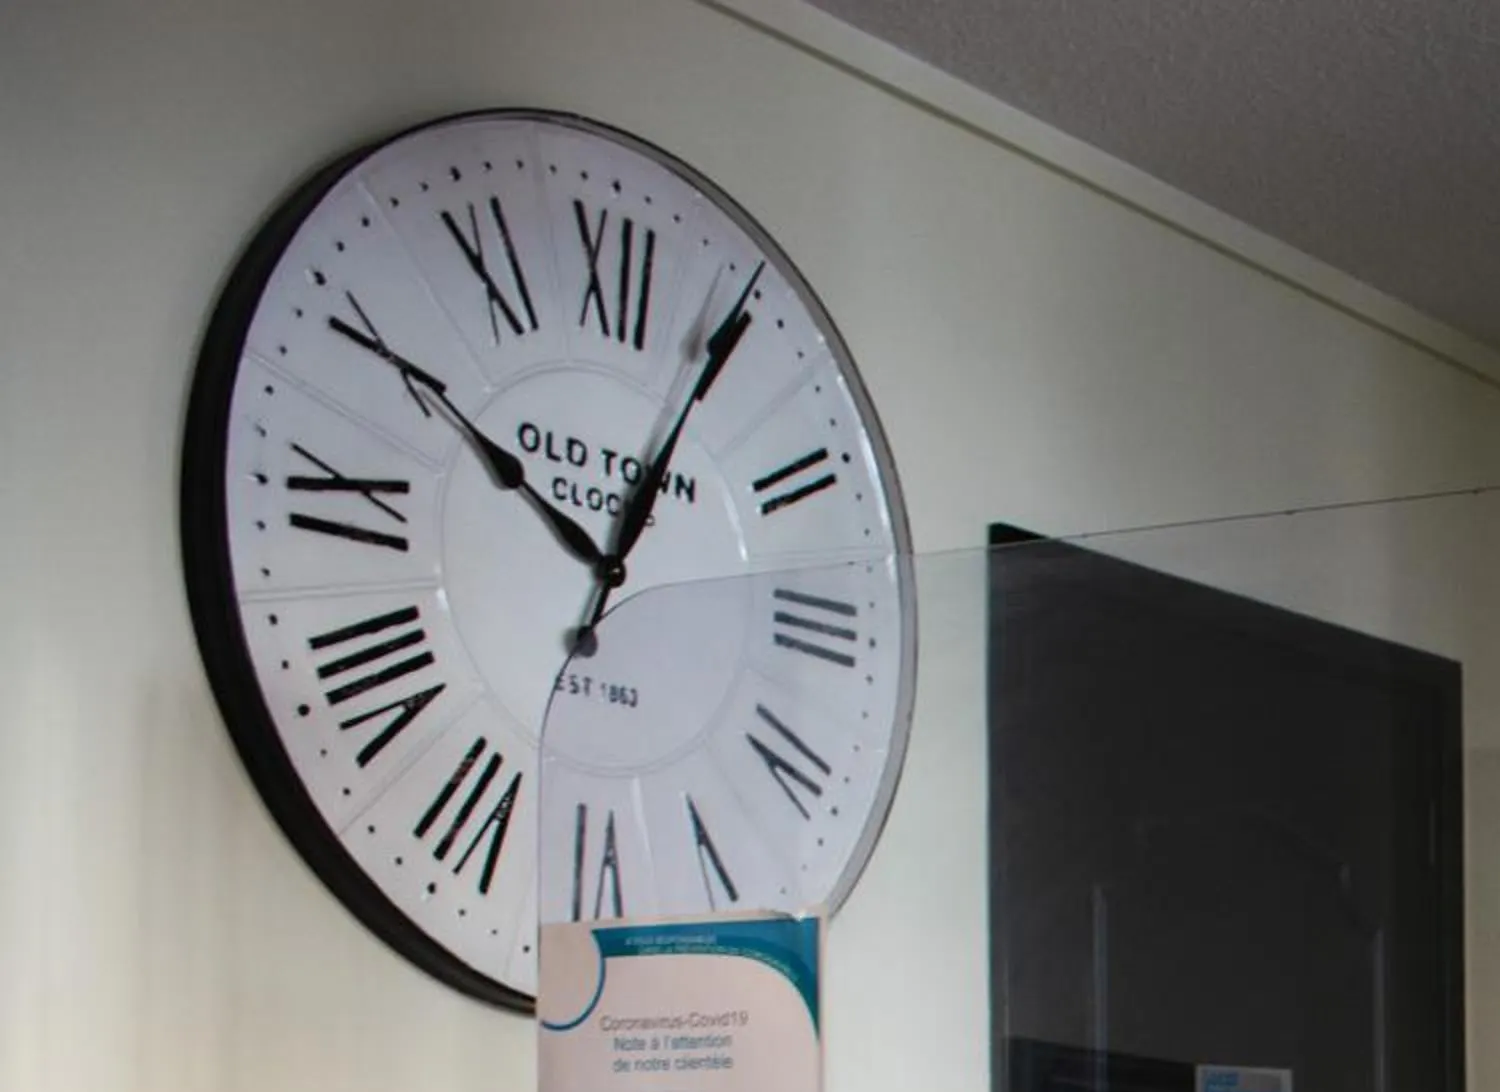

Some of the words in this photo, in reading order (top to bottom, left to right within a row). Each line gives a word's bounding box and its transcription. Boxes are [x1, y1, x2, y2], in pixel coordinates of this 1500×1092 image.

[573, 199, 655, 351] XII
[518, 422, 587, 467] OLD
[552, 477, 656, 527] CLOC
[613, 1057, 631, 1073] de
[634, 1056, 671, 1071] notre
[614, 1036, 646, 1052] Note
